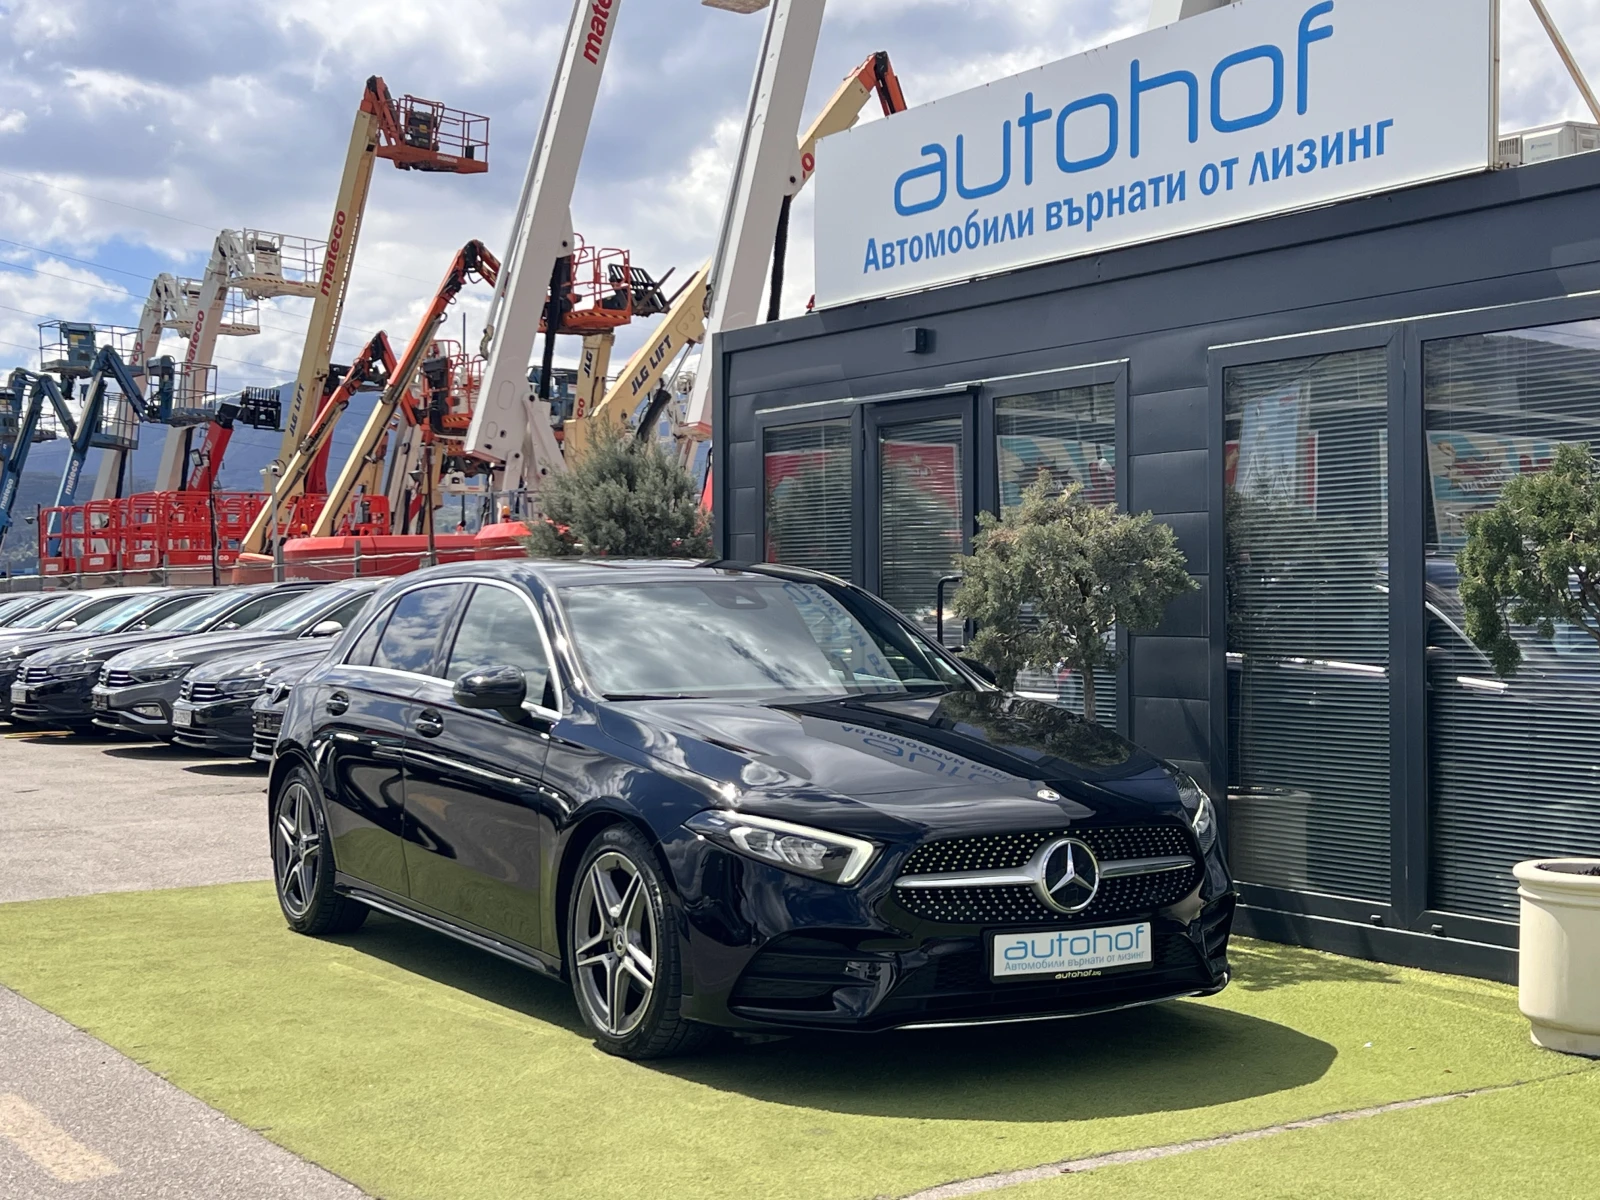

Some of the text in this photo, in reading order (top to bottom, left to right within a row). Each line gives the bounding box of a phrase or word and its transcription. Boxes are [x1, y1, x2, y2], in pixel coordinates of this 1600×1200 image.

[893, 0, 1335, 217] autohof
[863, 118, 1394, 273] Автомобили върнати от лизинг
[321, 210, 346, 297] mateco
[584, 350, 593, 378] JLG
[631, 334, 672, 396] JLG LIFT
[289, 383, 305, 437] JLG LIFT
[0, 478, 14, 510] mateco
[64, 460, 79, 495] mateco
[197, 553, 229, 561] maco
[1004, 925, 1145, 960] autohof
[1004, 950, 1145, 972] Автомобили върнати от лизинг
